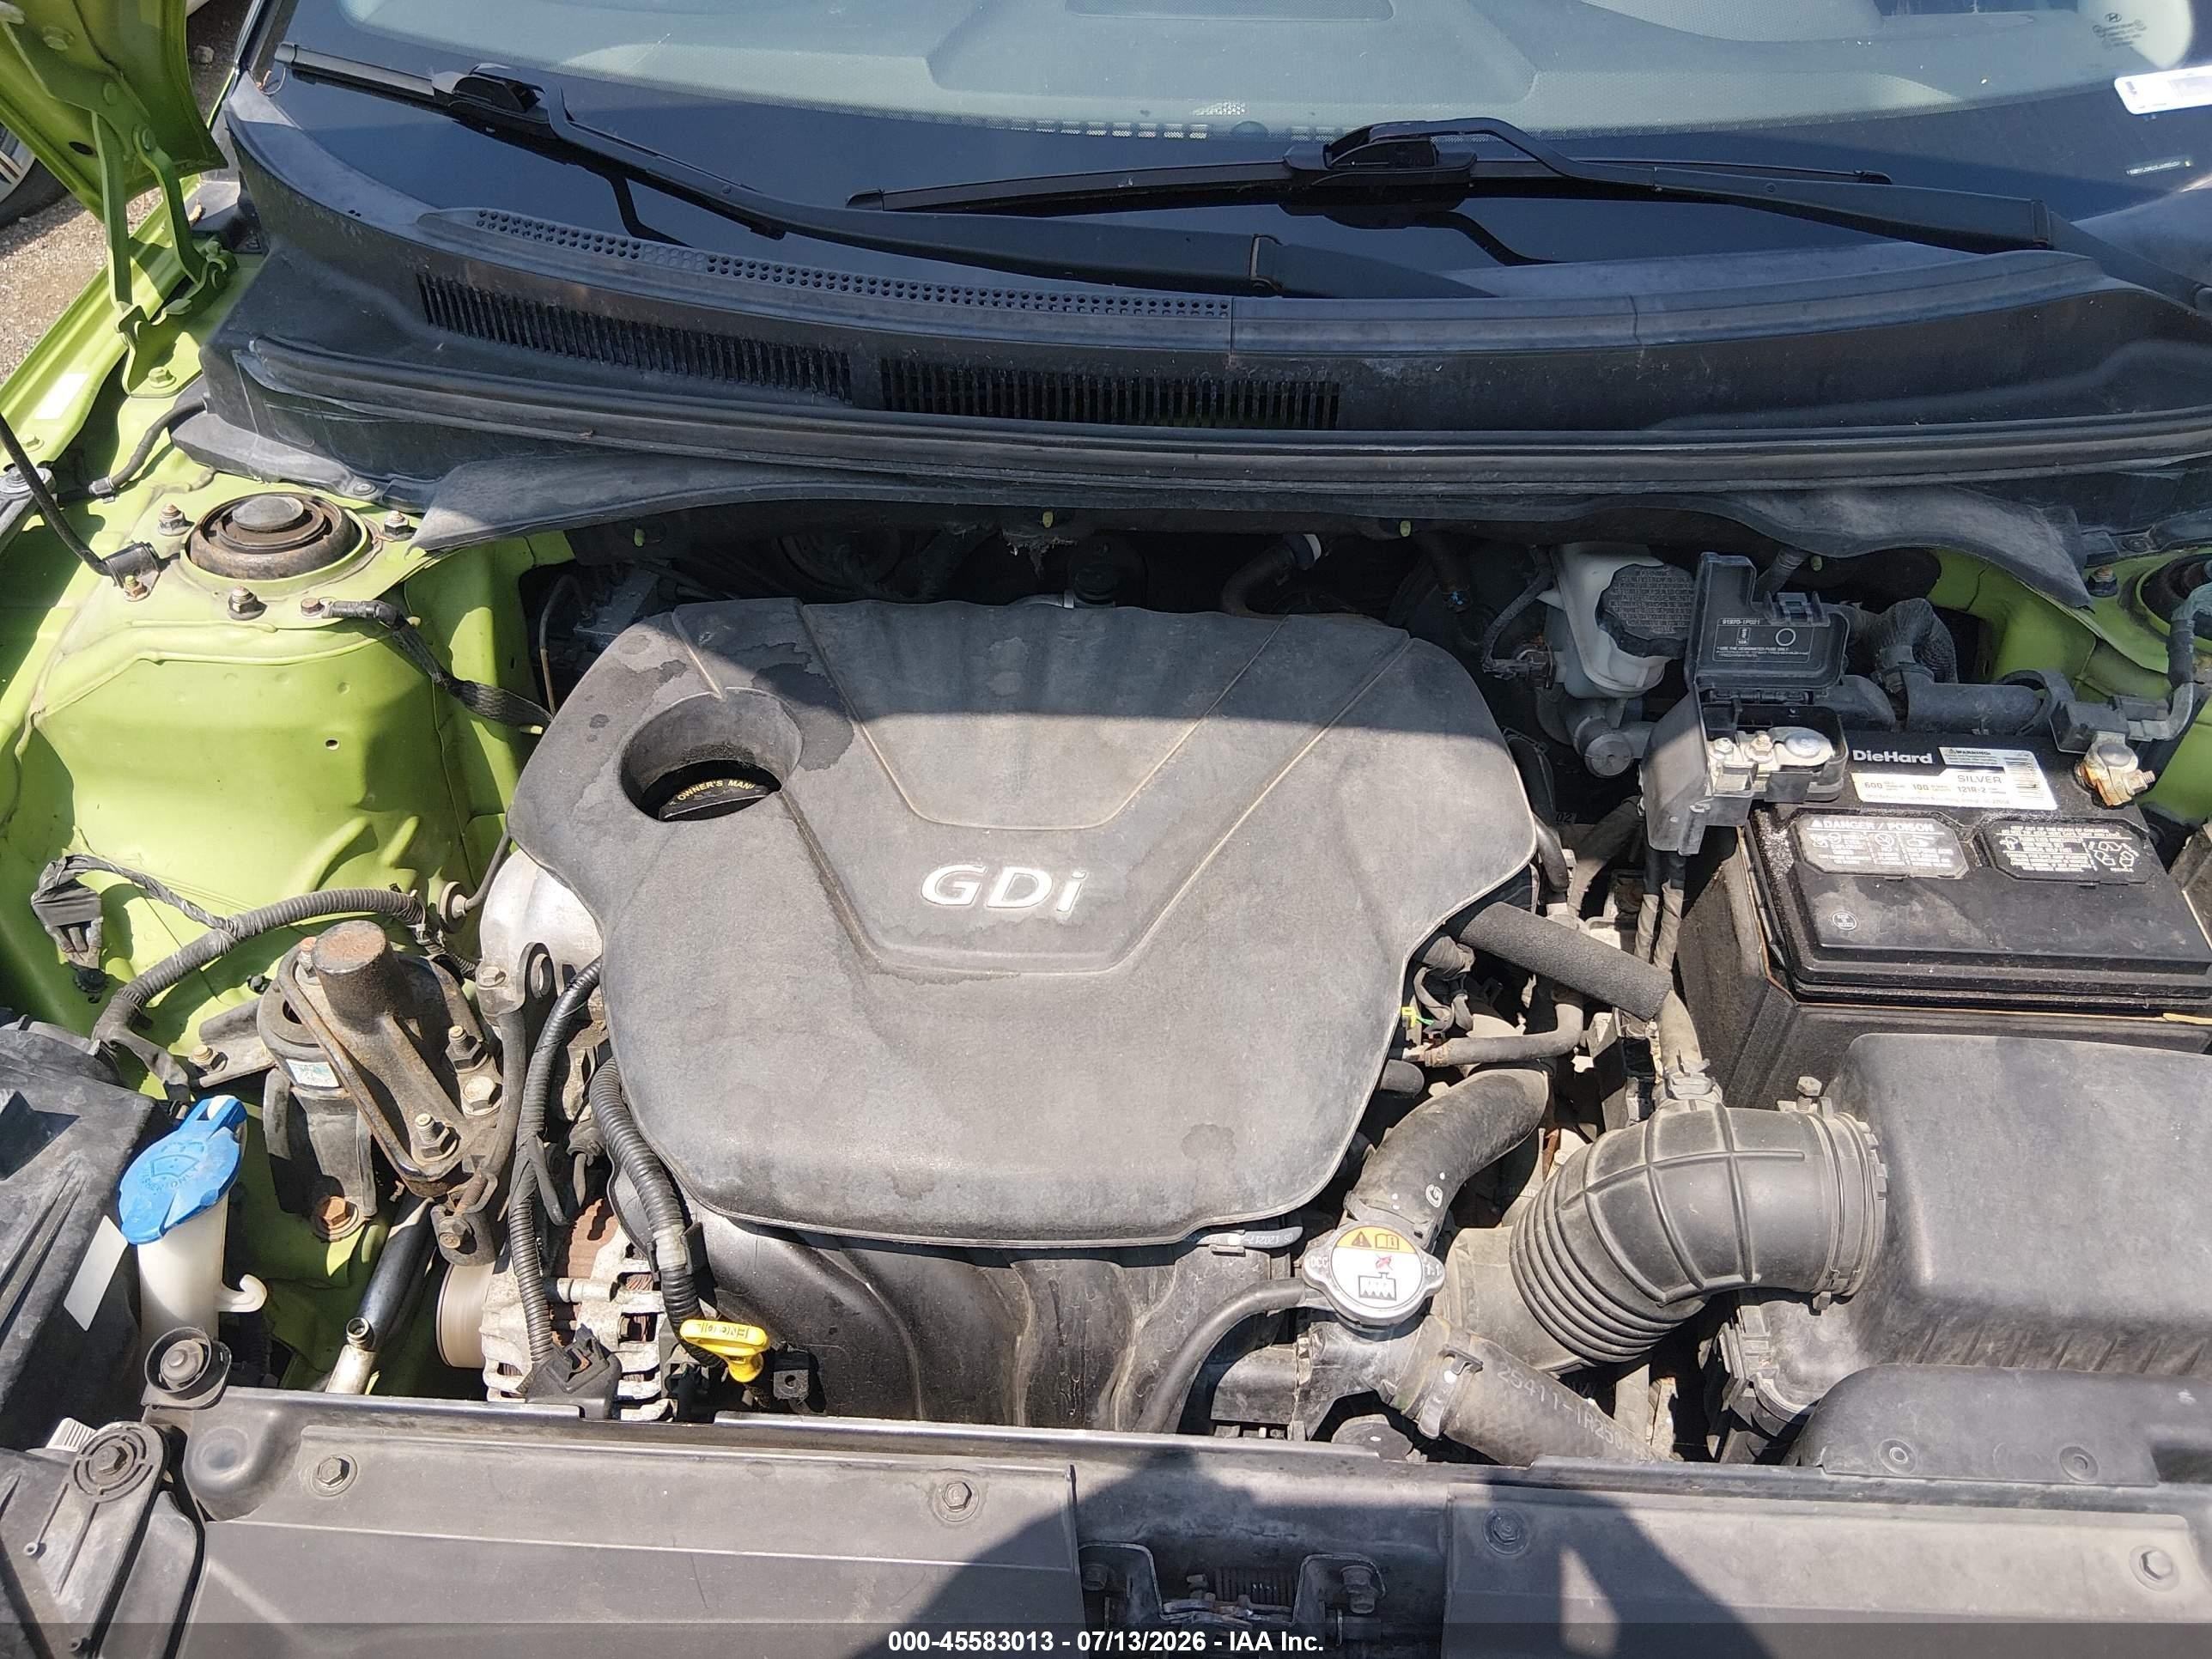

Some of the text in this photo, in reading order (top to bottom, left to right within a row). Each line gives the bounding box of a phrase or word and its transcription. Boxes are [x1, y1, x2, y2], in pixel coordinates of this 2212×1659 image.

[1852, 750, 1933, 764] DieHard
[1957, 775, 2002, 784] SILVER
[677, 780, 723, 801] OWNER'S
[1823, 820, 1875, 830] DANGER
[1887, 822, 1935, 832] POISON
[920, 863, 1088, 914] GDi
